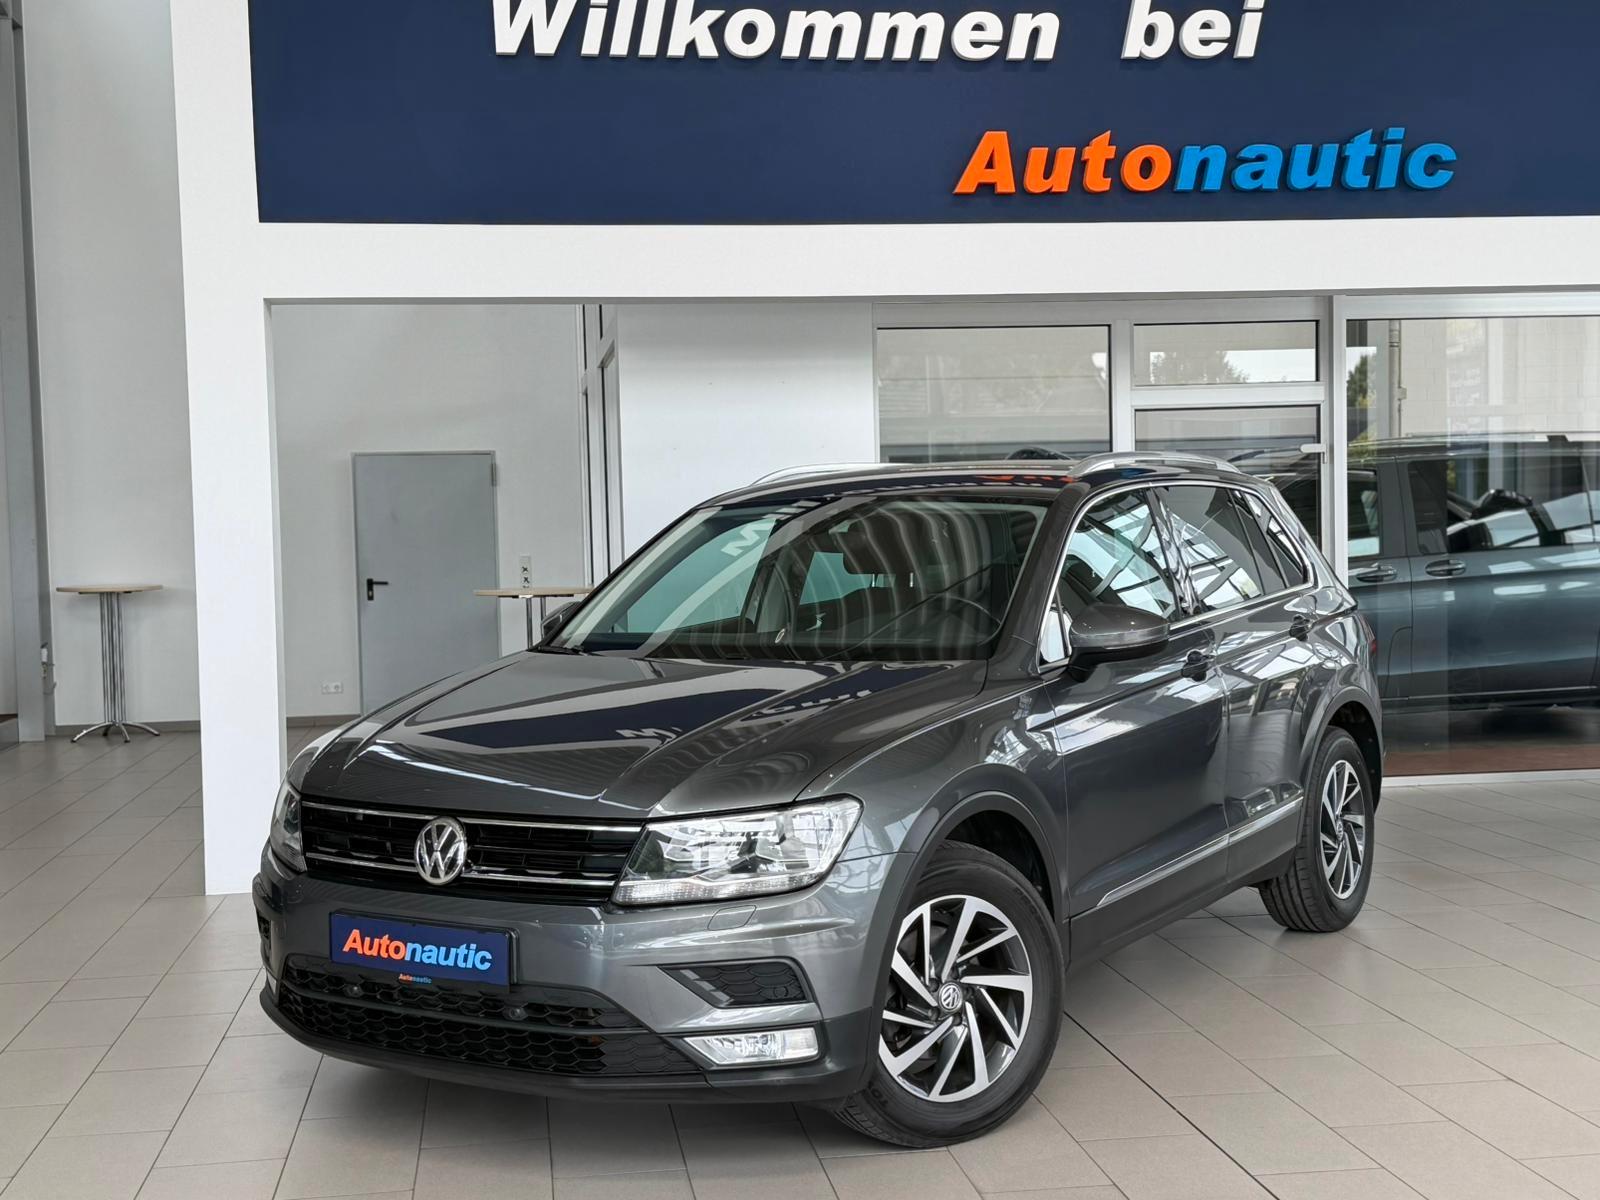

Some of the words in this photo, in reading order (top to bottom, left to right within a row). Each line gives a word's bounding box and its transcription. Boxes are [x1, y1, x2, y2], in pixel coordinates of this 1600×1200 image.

[492, 0, 1060, 62] Willkommen
[1120, 0, 1266, 60] bei
[952, 127, 1458, 195] Autonautic
[342, 928, 493, 971] Autonautic
